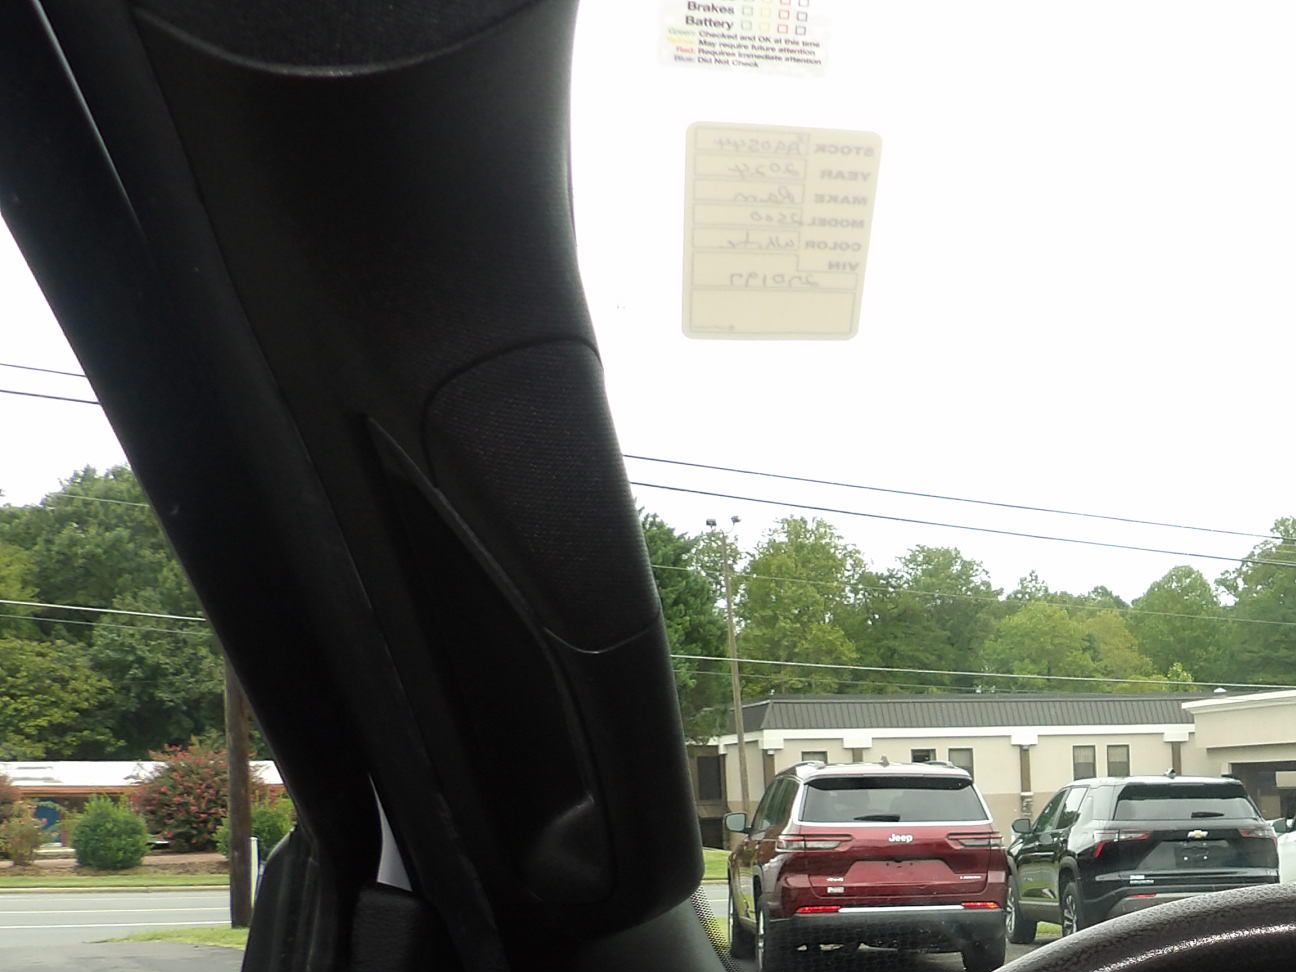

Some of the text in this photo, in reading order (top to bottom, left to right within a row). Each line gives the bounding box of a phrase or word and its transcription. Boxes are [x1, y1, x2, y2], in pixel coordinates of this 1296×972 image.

[687, 0, 735, 15] Brakes
[685, 15, 734, 30] Battery
[699, 31, 738, 40] Checked
[698, 39, 716, 48] May
[778, 47, 816, 56] attention
[784, 56, 822, 65] attention
[888, 833, 913, 843] Jeep
